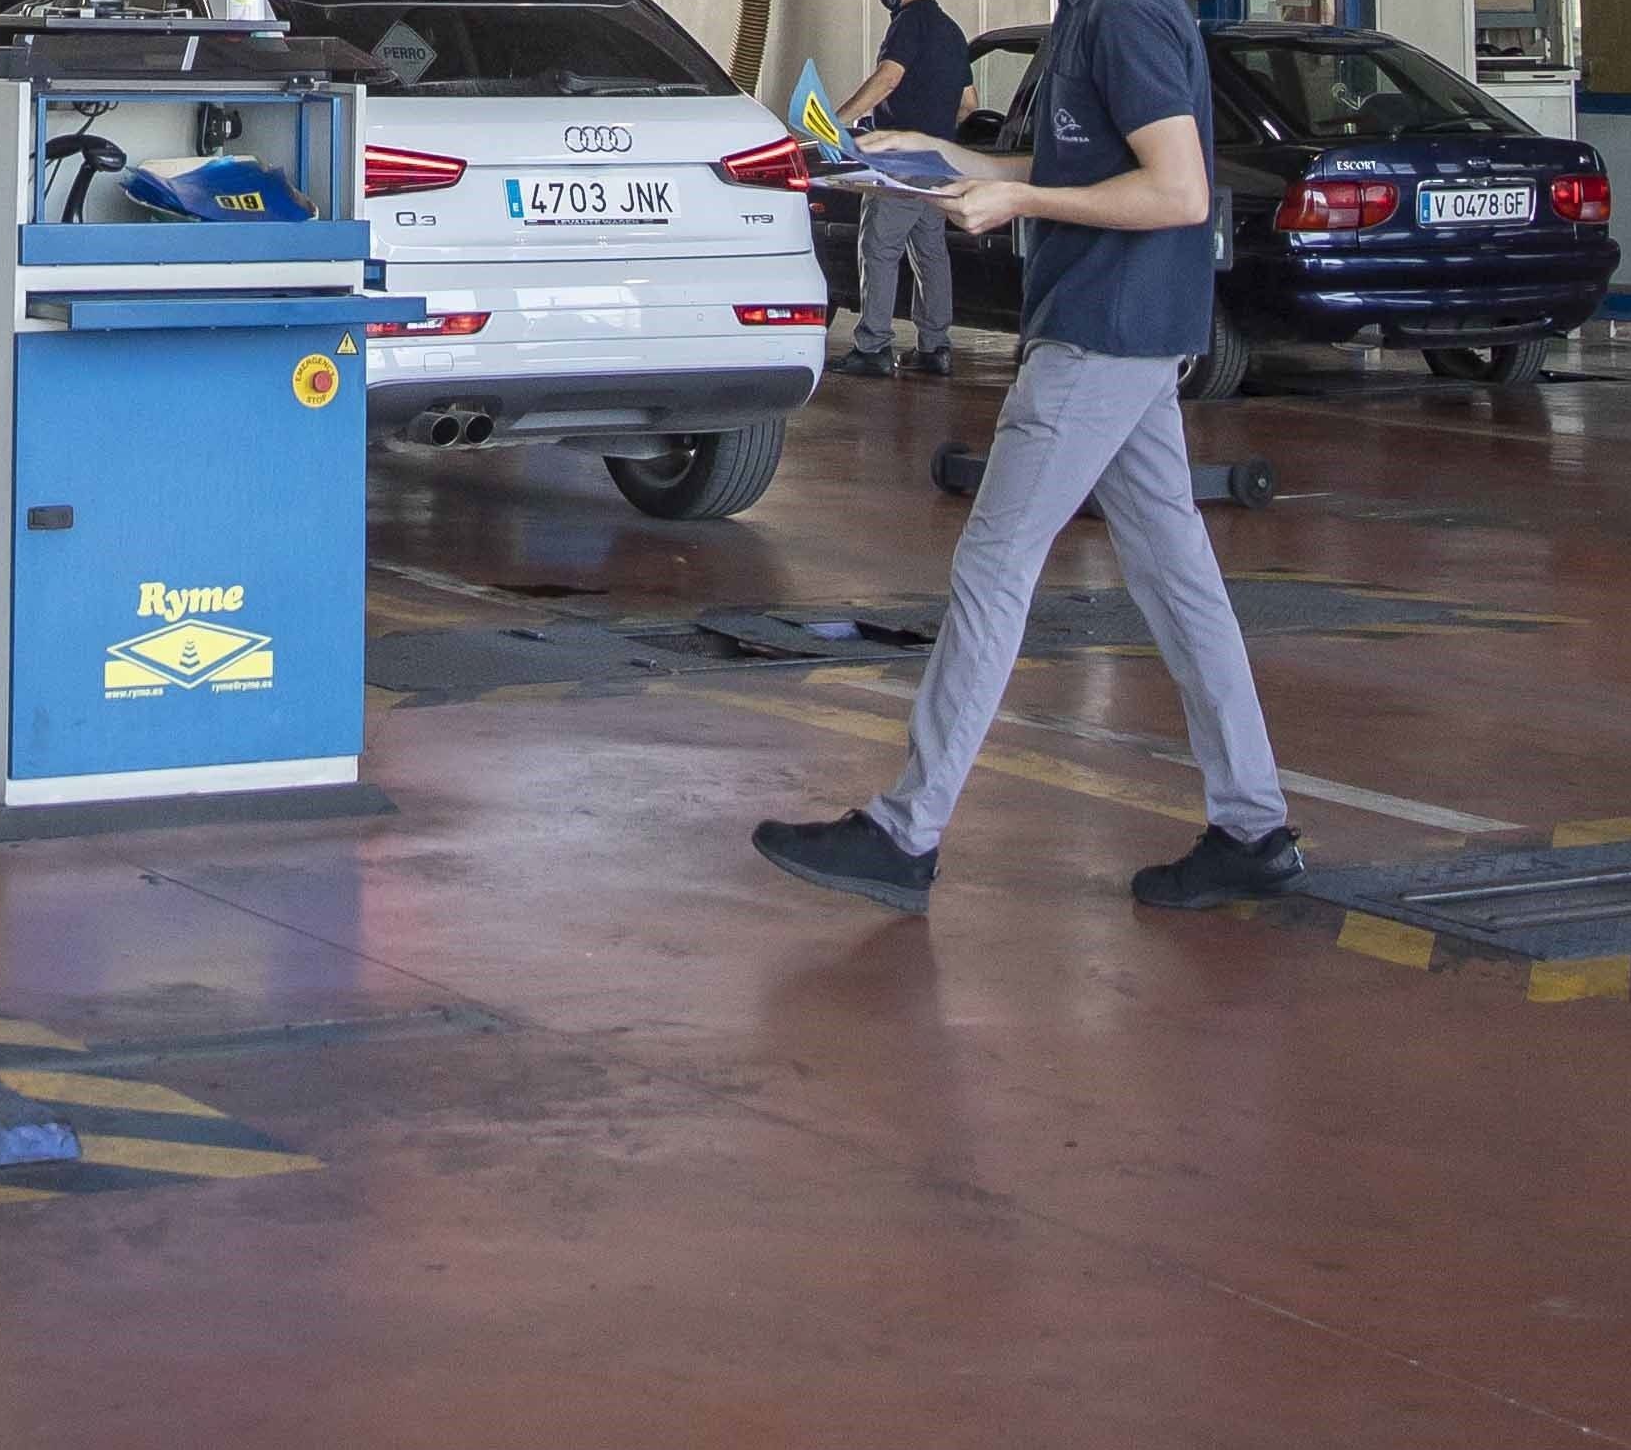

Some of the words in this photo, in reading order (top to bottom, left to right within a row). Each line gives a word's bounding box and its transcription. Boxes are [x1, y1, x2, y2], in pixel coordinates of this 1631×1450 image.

[384, 46, 426, 60] PERRO
[1336, 160, 1376, 171] ESCORT
[531, 182, 607, 214] 4703
[619, 182, 674, 214] JNK
[1434, 195, 1446, 218] V
[1453, 193, 1499, 218] 0478
[1504, 192, 1526, 215] GF
[396, 211, 437, 227] Q3
[740, 213, 775, 225] TFSI
[295, 356, 335, 382] EMERGENCY
[305, 393, 327, 405] STOP
[137, 581, 245, 623] Ryme
[104, 687, 164, 700] www.ryme.es
